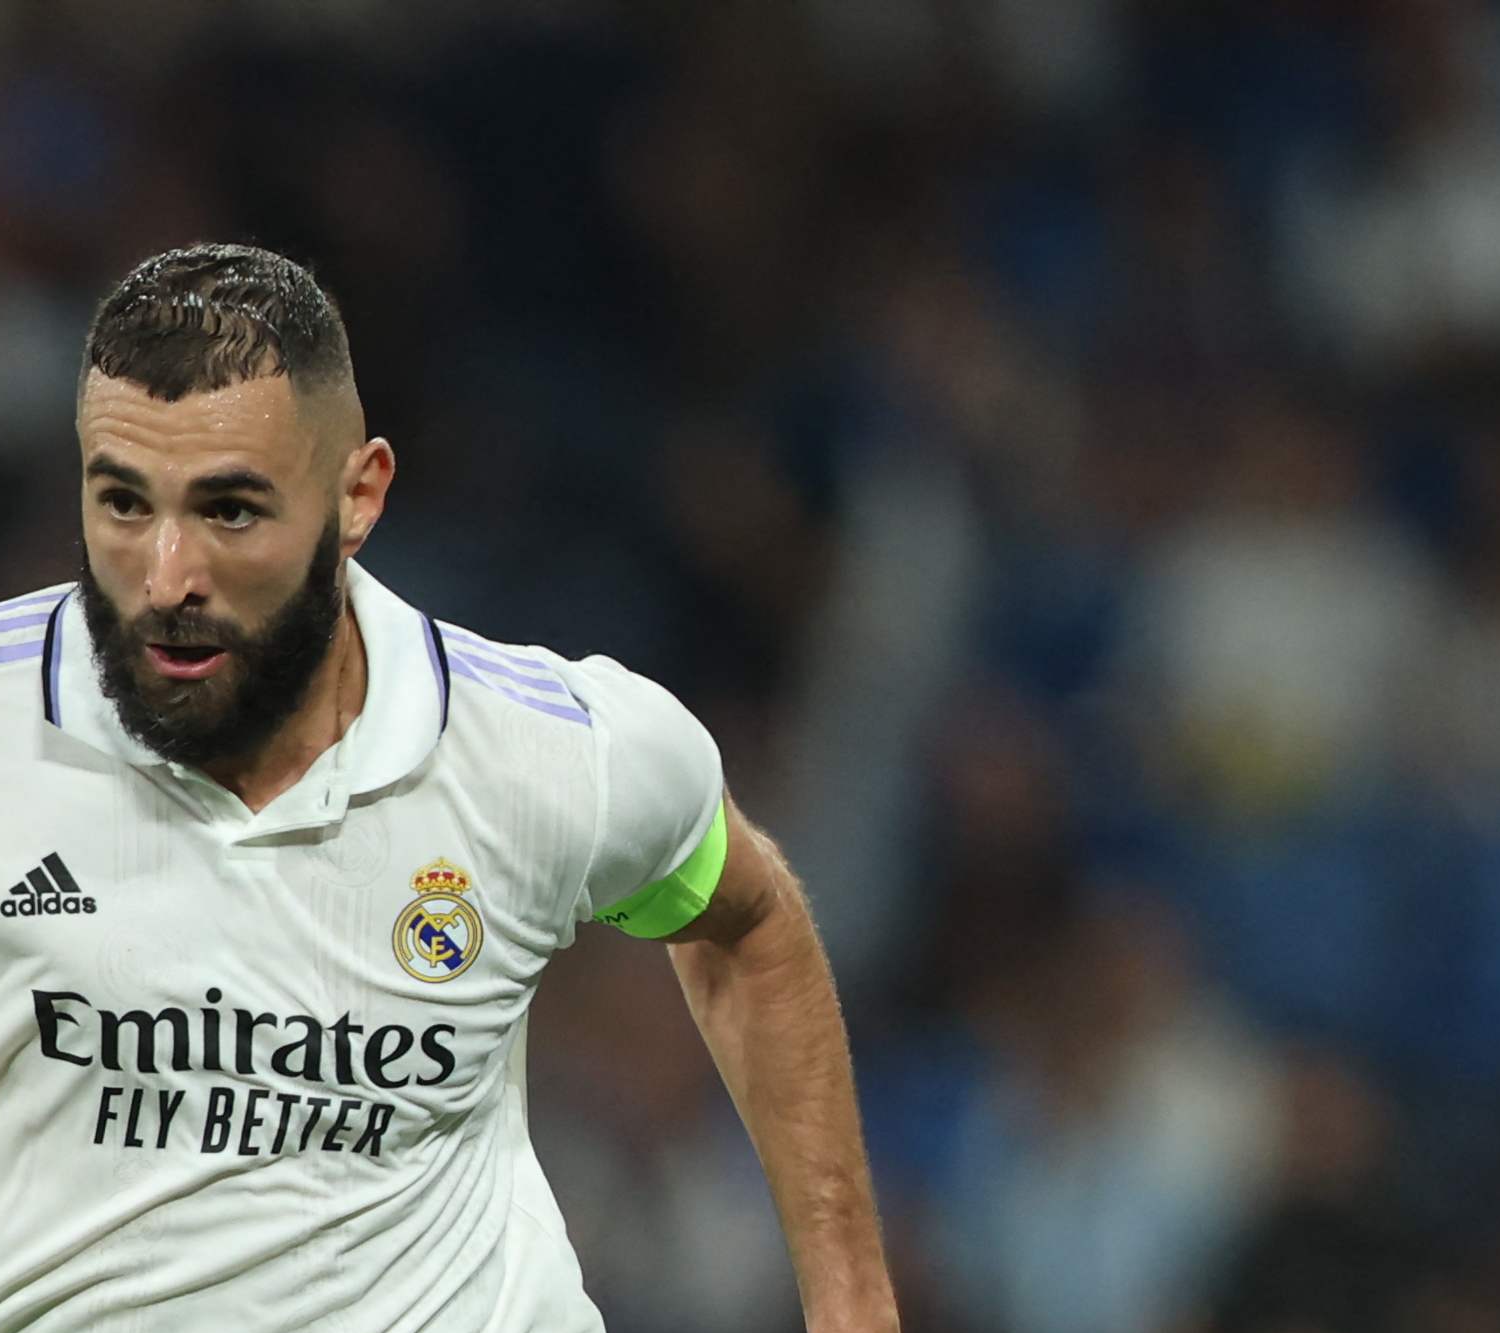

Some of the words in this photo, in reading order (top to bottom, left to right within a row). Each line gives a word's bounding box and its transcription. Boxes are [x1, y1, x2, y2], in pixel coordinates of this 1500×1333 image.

[0, 892, 97, 917] adidas
[32, 987, 456, 1088] Emirates
[93, 1087, 186, 1149] FLY
[200, 1087, 396, 1157] BETTER
